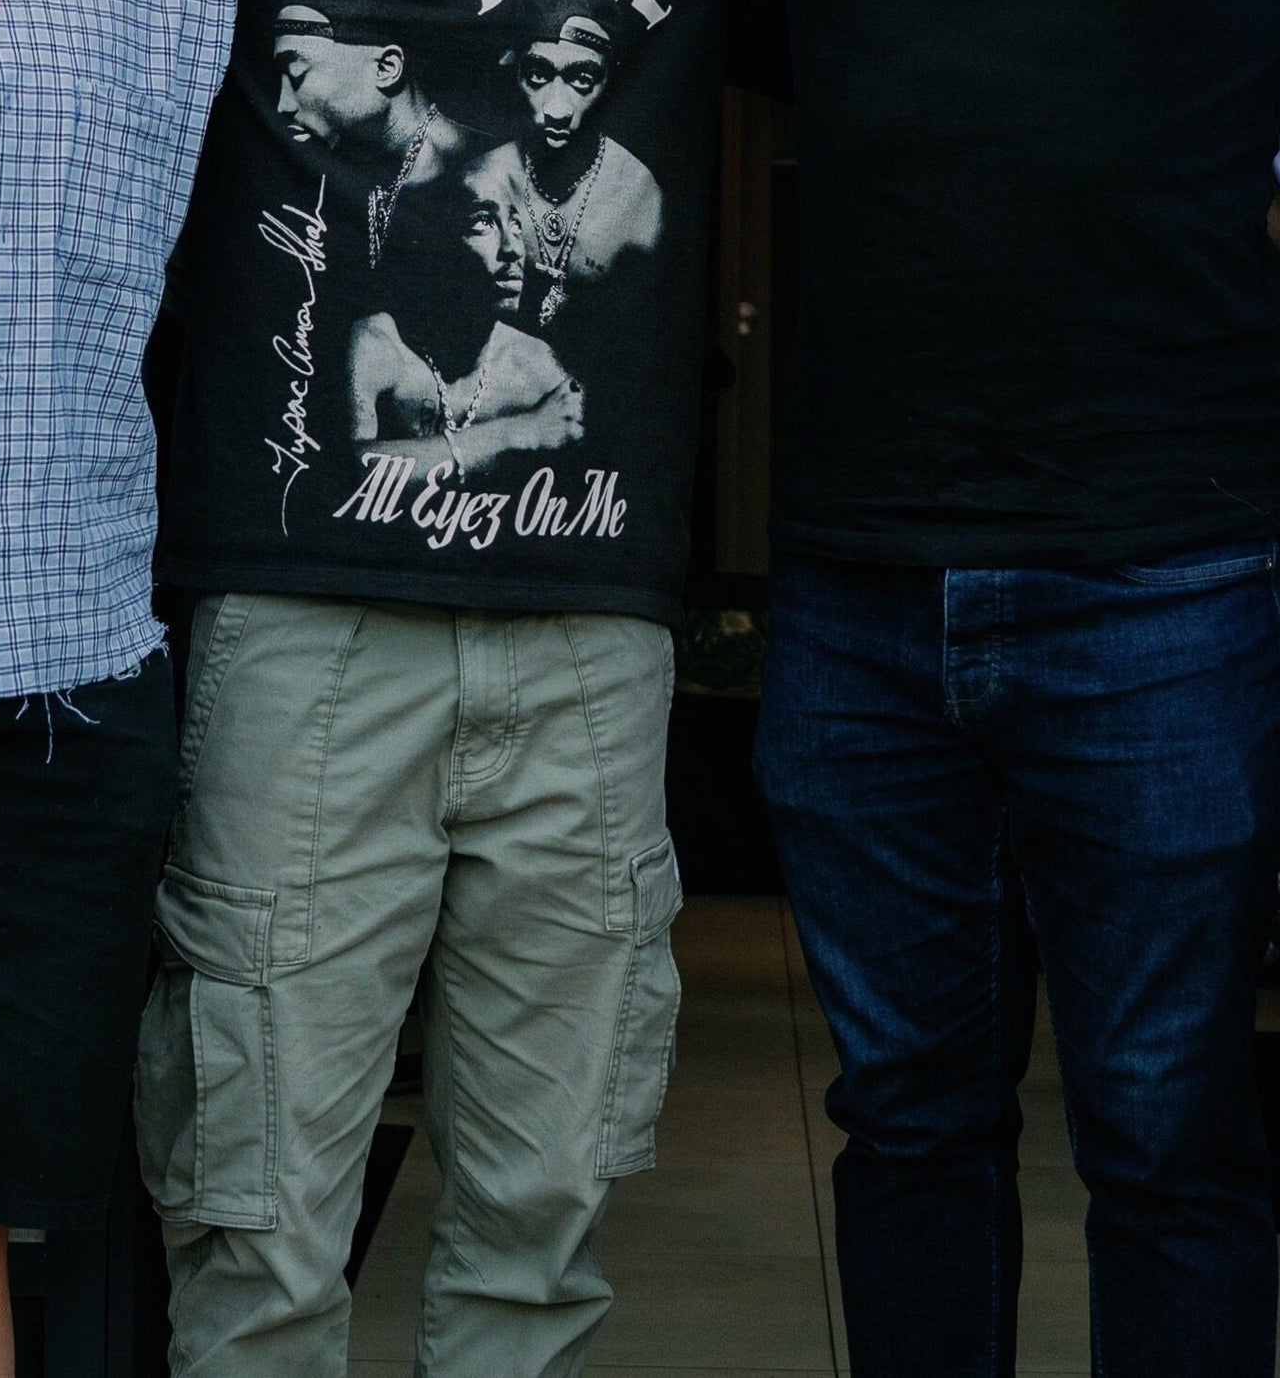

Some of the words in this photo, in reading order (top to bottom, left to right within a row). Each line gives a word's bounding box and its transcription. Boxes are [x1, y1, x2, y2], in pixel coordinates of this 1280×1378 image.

[332, 451, 416, 524] All
[410, 460, 511, 550] Eyez
[514, 466, 570, 536] On
[563, 468, 627, 538] Me
